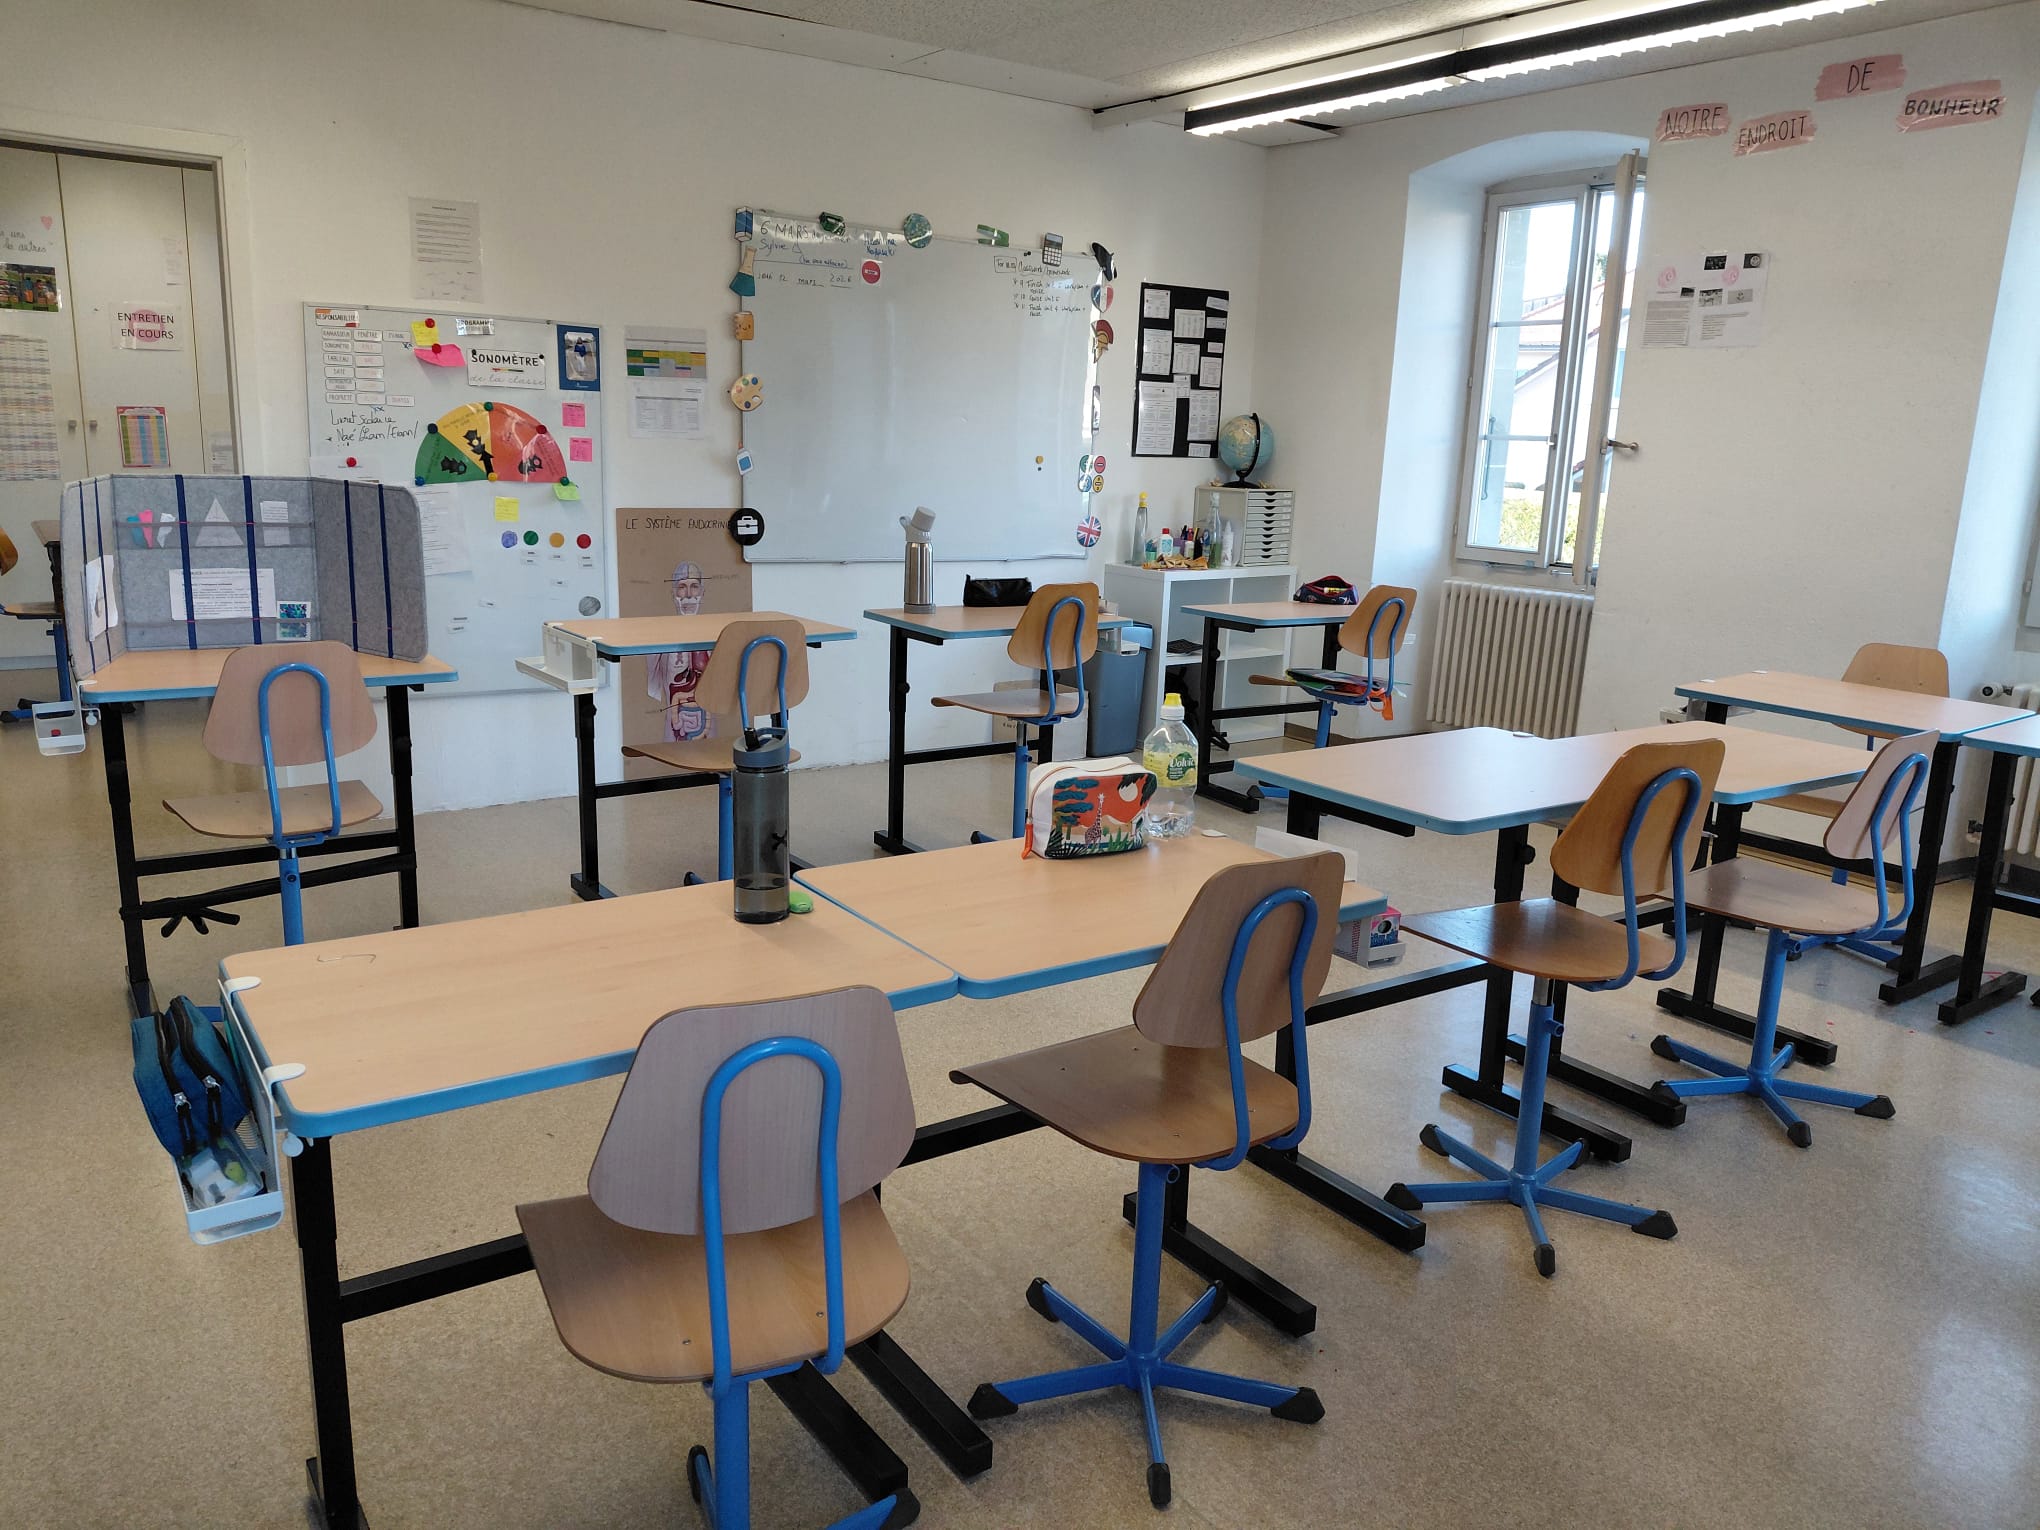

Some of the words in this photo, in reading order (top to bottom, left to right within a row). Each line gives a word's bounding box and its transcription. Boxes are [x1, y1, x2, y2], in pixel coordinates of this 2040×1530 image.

[1664, 106, 1724, 136] NOTRE
[1738, 115, 1808, 147] ENDROIT
[1847, 61, 1876, 94] DE
[1904, 98, 2000, 116] BONHEUR
[774, 223, 809, 240] MARS
[759, 238, 789, 257] Sylvie
[117, 312, 175, 324] ENTRETIEN
[121, 328, 135, 338] EN
[138, 329, 174, 340] COURS
[471, 353, 539, 367] SONOMÈTRE
[488, 373, 505, 383] la
[507, 375, 545, 386] classe
[625, 518, 638, 530] LE
[645, 515, 681, 530] SYSTÈME
[688, 518, 730, 530] ENDOCRINI
[1170, 758, 1194, 768] Volvic
